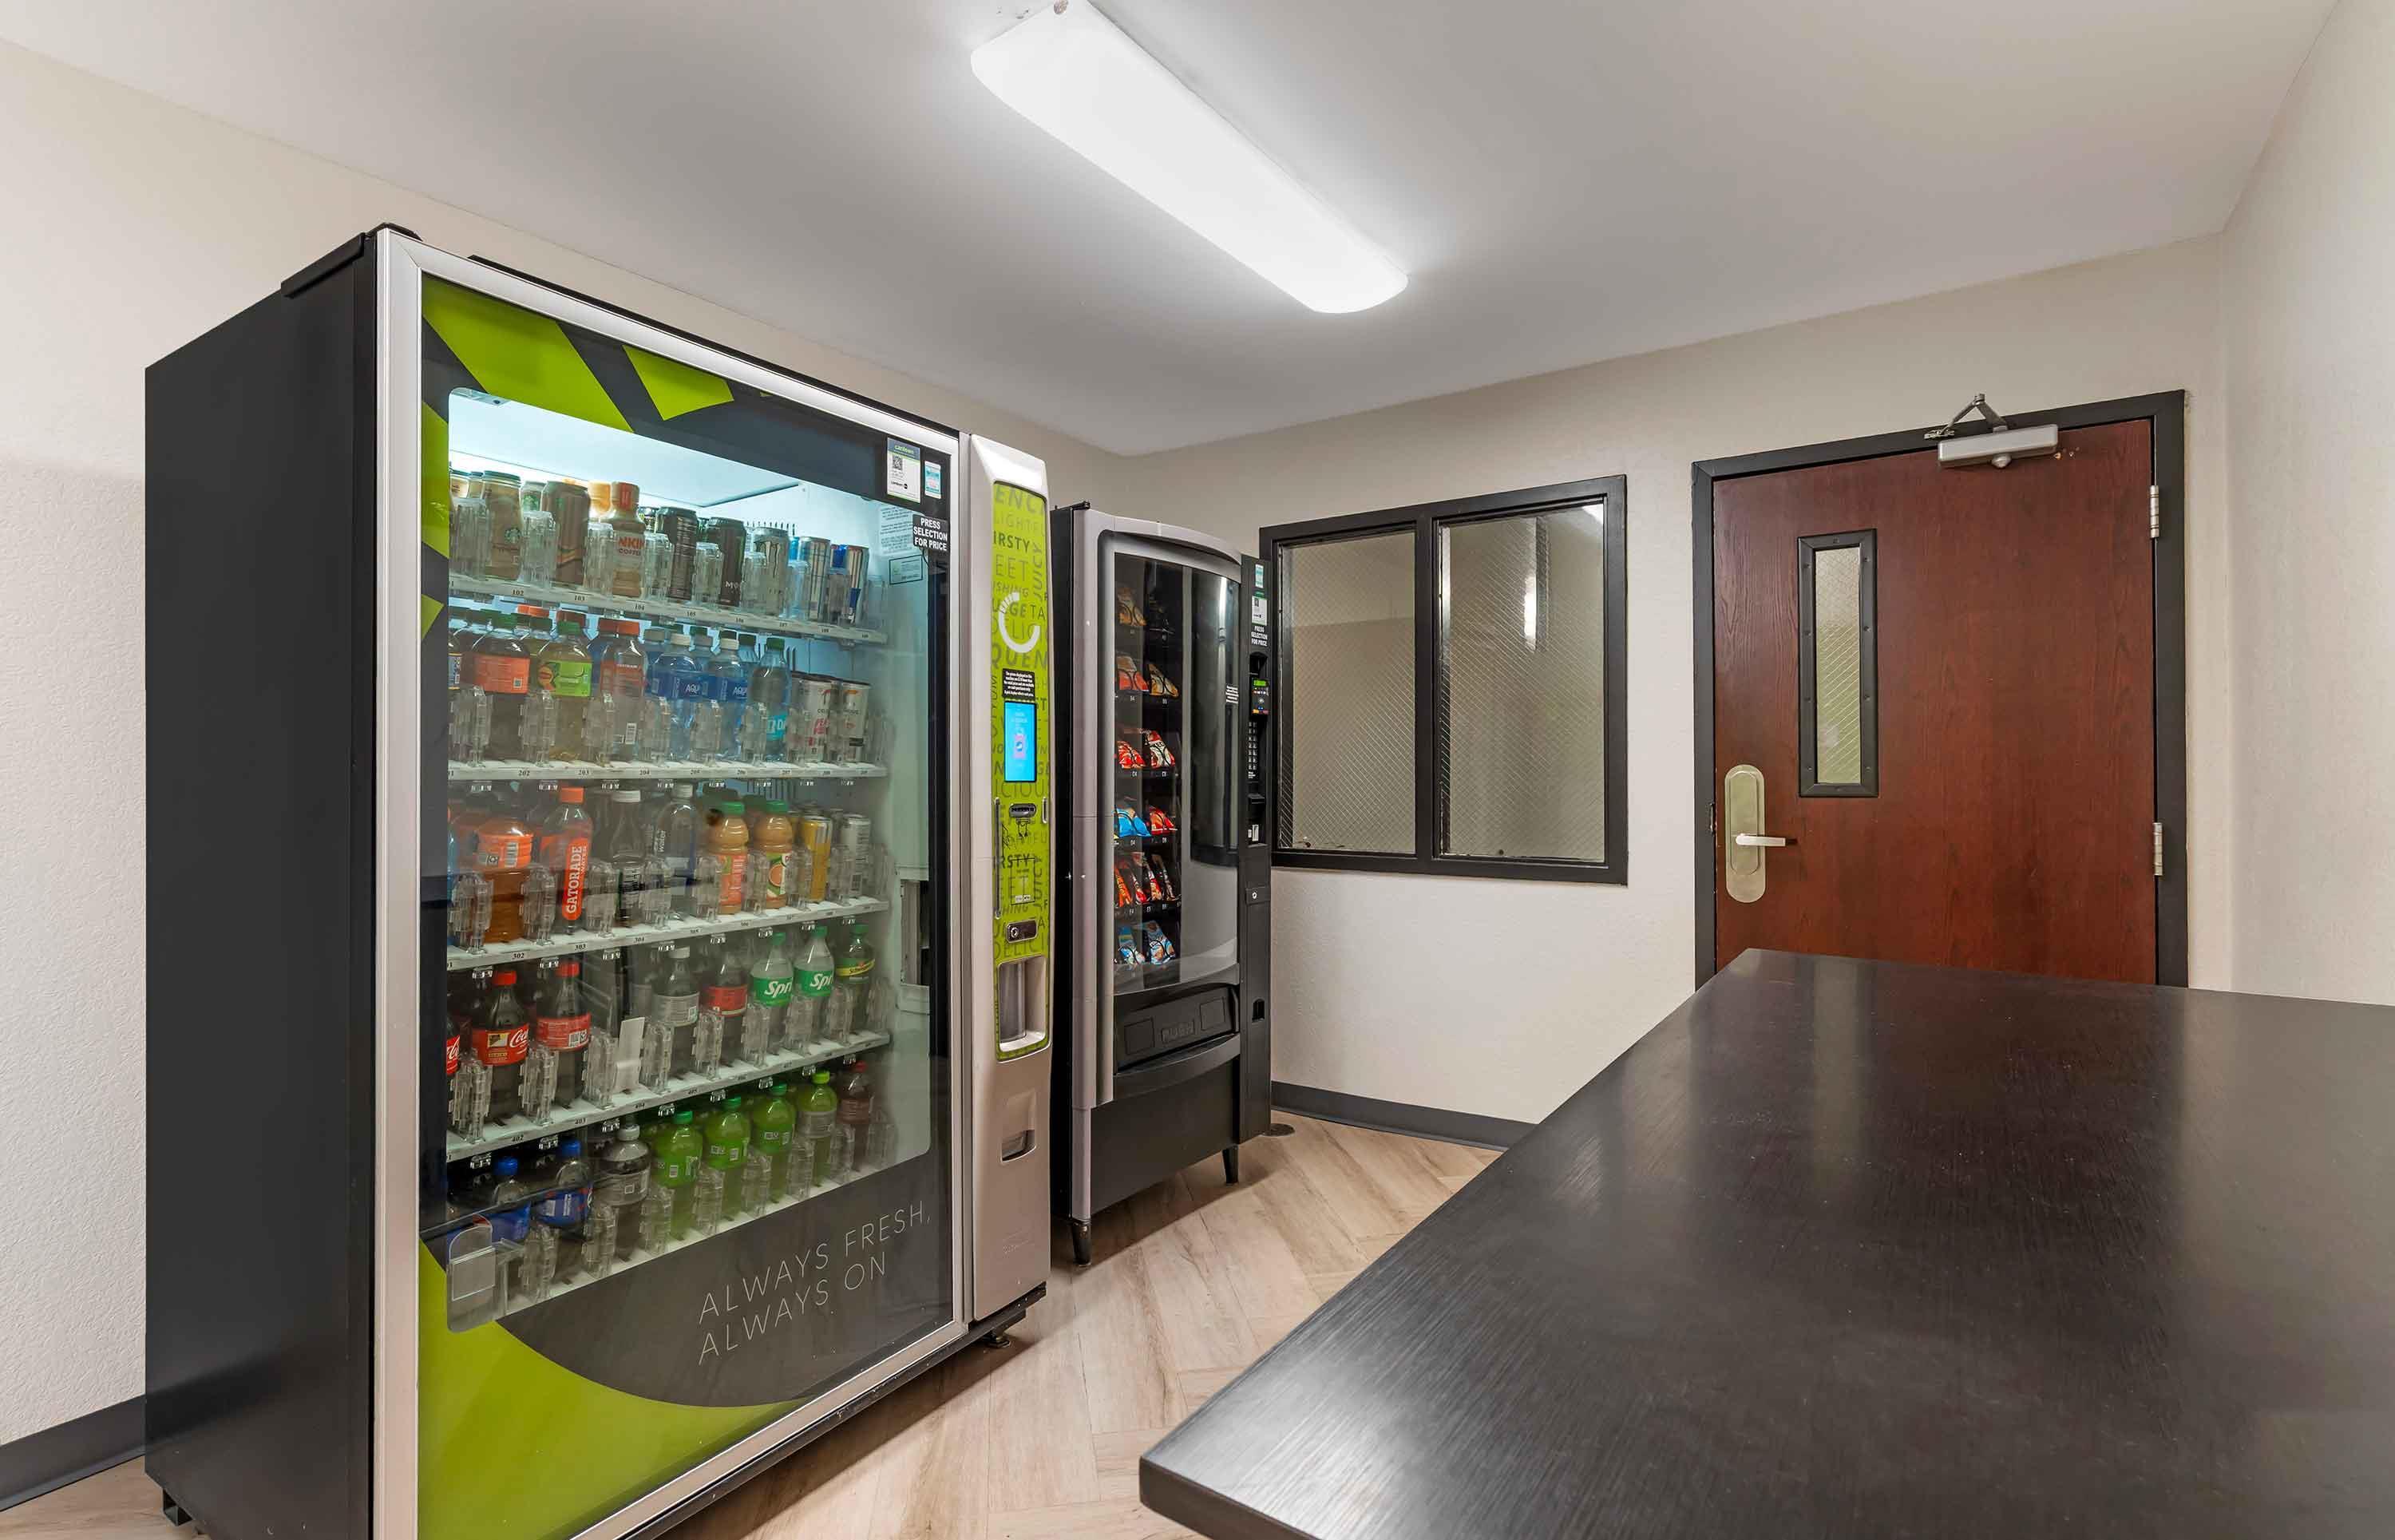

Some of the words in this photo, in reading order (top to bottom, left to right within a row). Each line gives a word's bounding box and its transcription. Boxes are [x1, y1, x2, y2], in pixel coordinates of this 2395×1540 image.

[913, 527, 948, 541] SELECTION
[920, 517, 940, 529] PRESS
[914, 537, 928, 548] FOR
[928, 538, 947, 551] PRICE
[566, 845, 582, 914] GATORADE
[699, 1243, 829, 1324] ALWAYS
[845, 1200, 932, 1257] FRESH,
[699, 1279, 829, 1366] ALWAYS
[845, 1251, 885, 1290] ON
